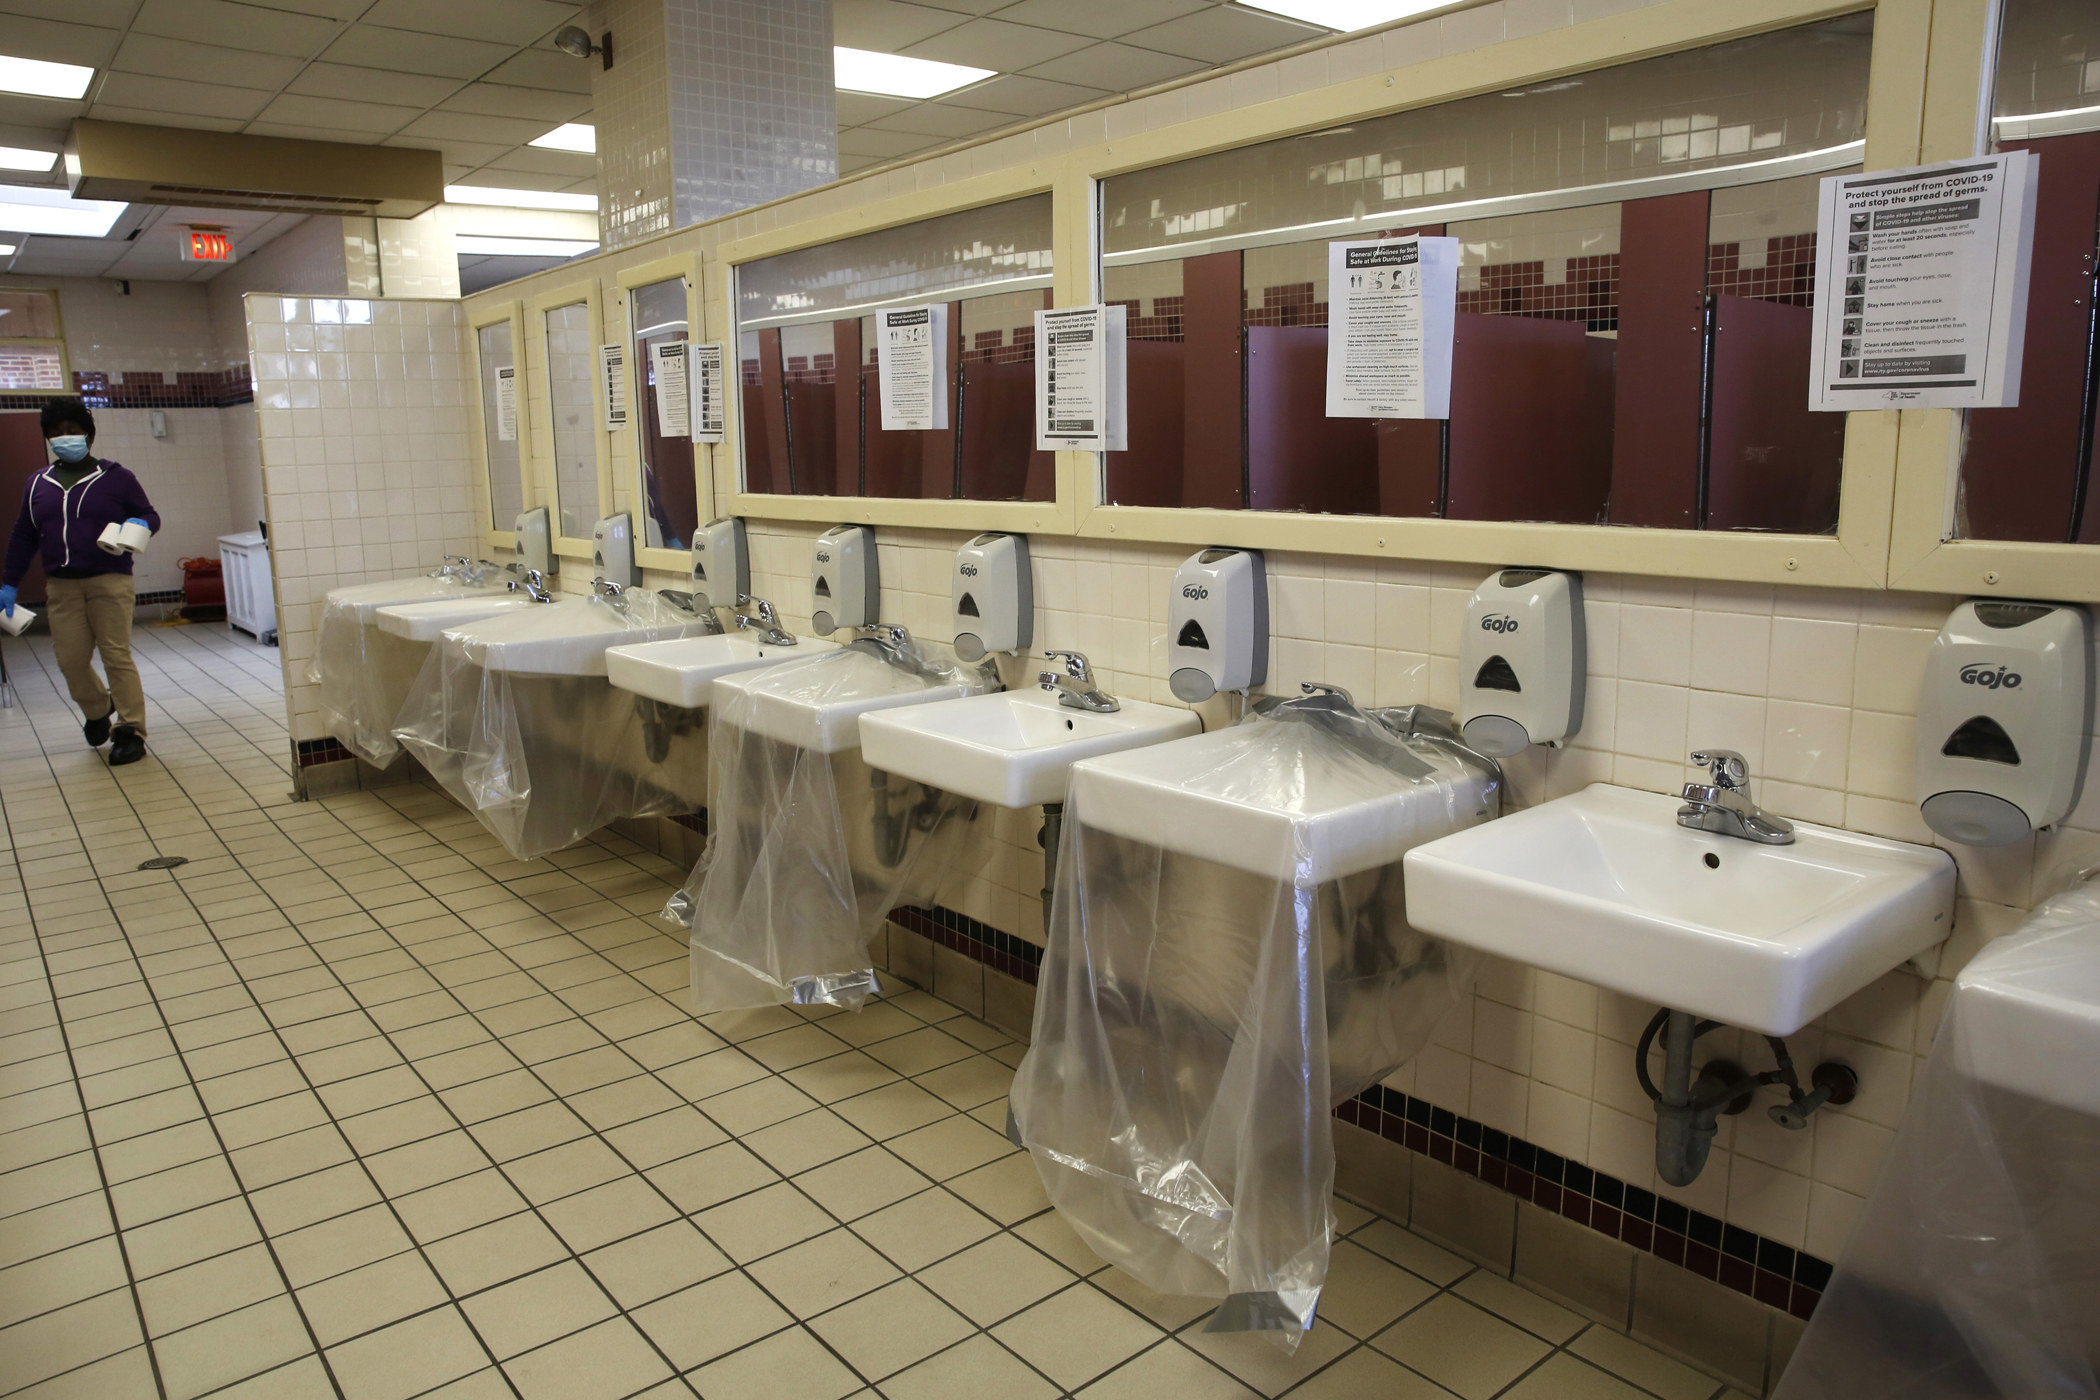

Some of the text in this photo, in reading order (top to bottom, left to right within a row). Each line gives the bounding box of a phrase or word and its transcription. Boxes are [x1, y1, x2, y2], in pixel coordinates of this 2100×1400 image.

[1846, 174, 1994, 199] Protect yourself from COVID-19
[1868, 198, 1888, 208] stop
[1908, 192, 1940, 202] spread
[1943, 189, 1954, 197] of
[1955, 186, 1988, 197] germs.
[1876, 213, 1895, 221] Simple
[1912, 210, 1924, 218] help
[192, 233, 227, 260] EXIT
[960, 564, 978, 577] GOJO
[1182, 584, 1208, 600] GOJO
[1481, 614, 1518, 634] GOJO
[1960, 664, 2022, 690] GOJO
